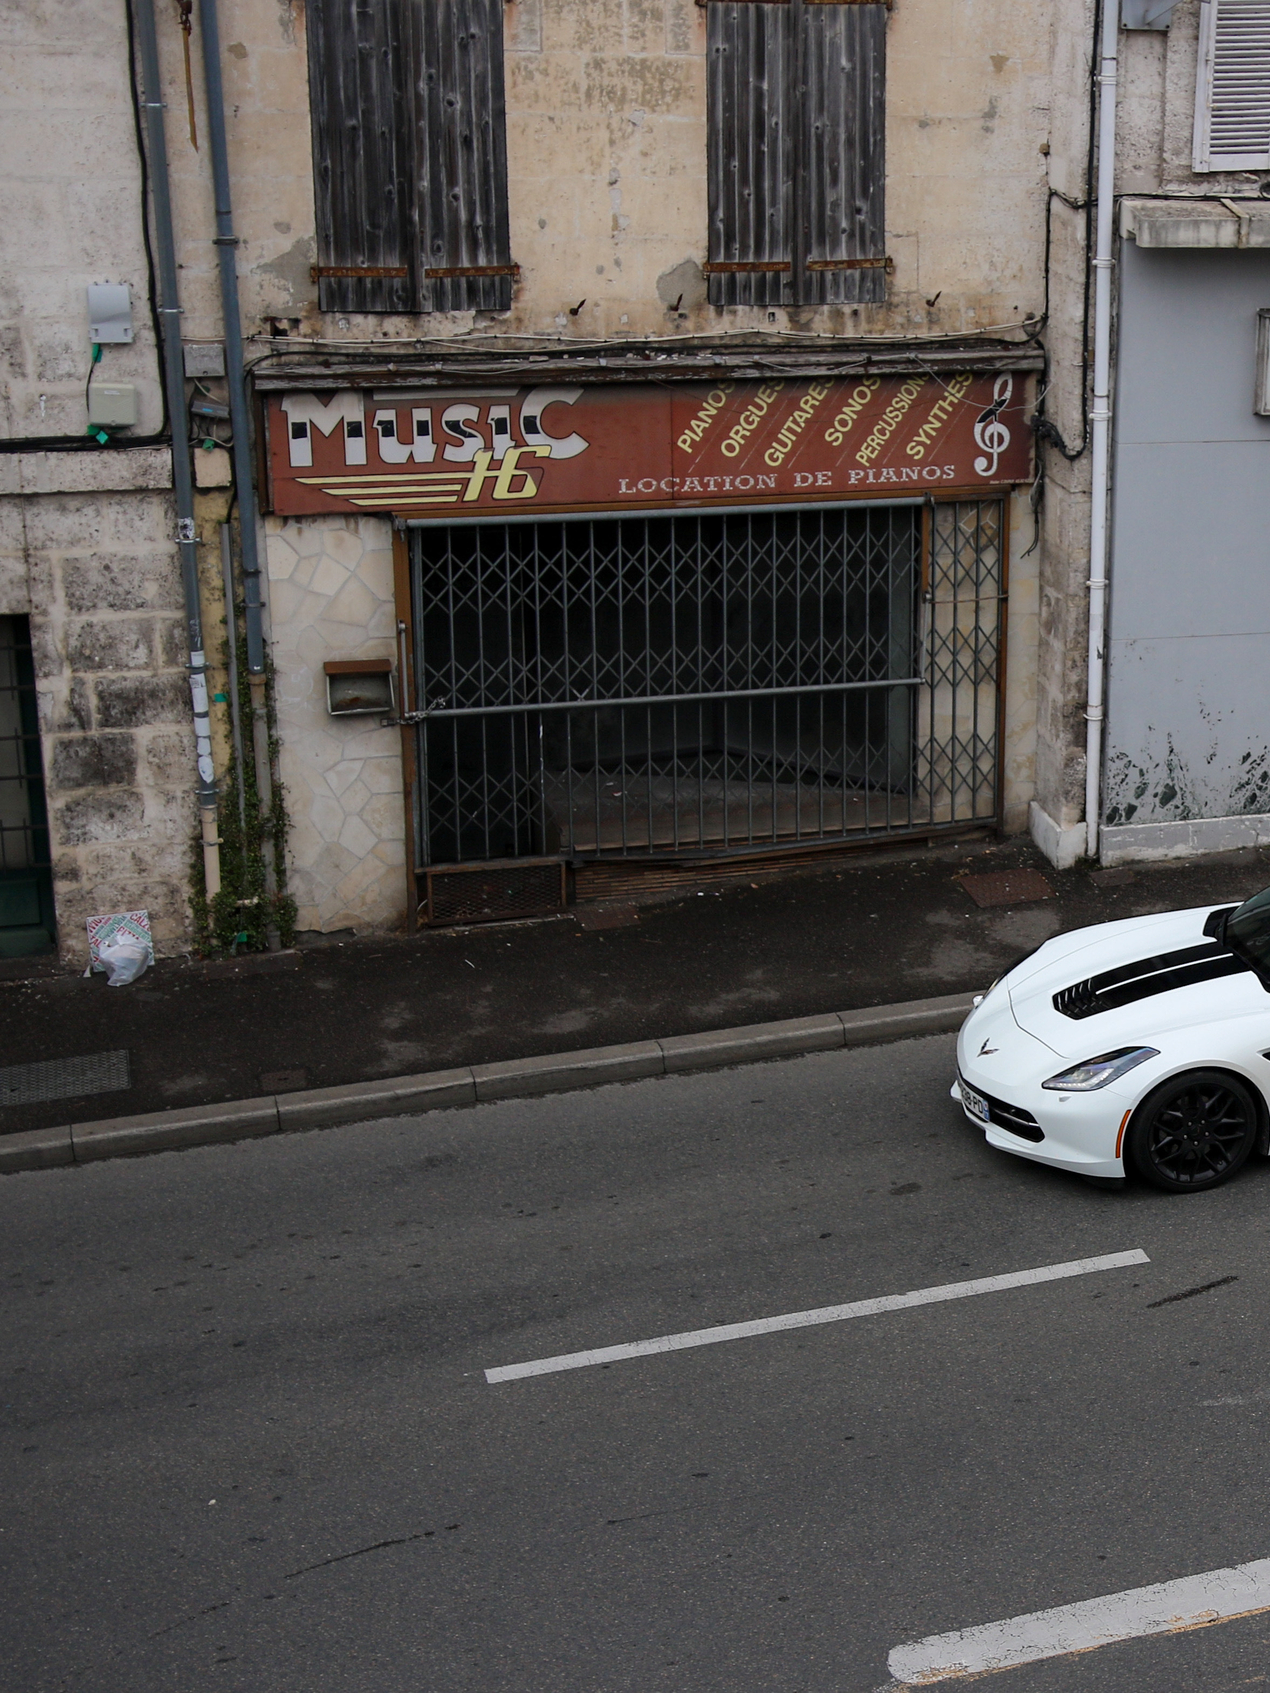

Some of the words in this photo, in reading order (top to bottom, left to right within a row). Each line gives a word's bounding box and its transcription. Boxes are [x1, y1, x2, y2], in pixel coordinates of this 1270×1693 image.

[677, 379, 736, 454] PIANOS
[720, 377, 785, 457] ORGUES
[764, 376, 835, 467] GUITARES
[824, 374, 881, 446] SONOS
[618, 474, 778, 494] LOCATION
[793, 471, 832, 488] DE
[848, 464, 955, 484] PIANOS
